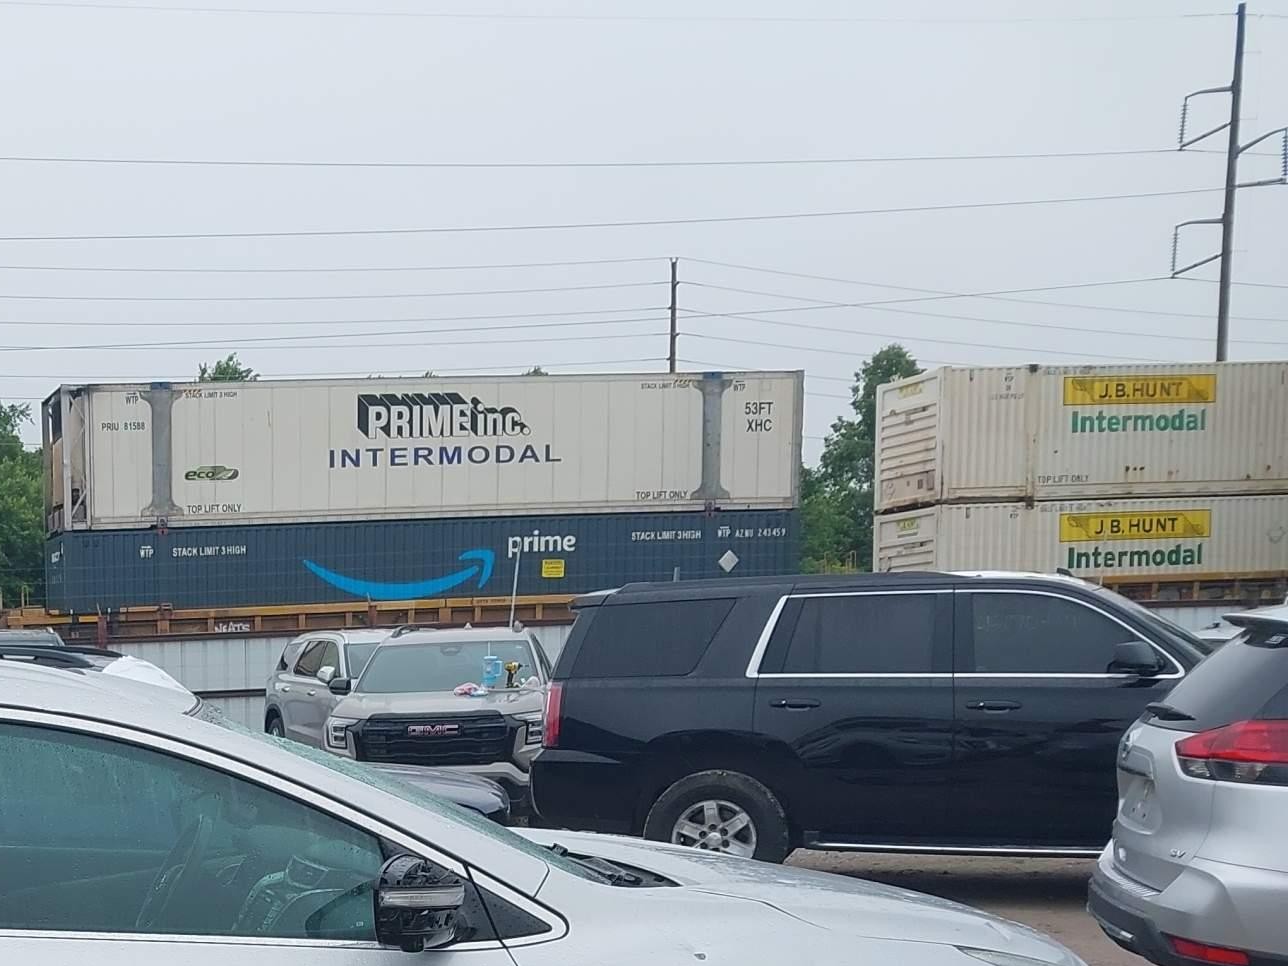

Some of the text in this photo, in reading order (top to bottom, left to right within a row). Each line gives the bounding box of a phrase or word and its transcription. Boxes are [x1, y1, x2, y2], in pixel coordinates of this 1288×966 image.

[125, 395, 139, 405] WTP
[744, 401, 774, 415] 53FT
[357, 392, 531, 439] PRIME inc.
[1071, 408, 1206, 433] Intermodal
[746, 419, 773, 433] XHC
[328, 444, 562, 468] INTERMODAL
[184, 469, 215, 480] eco
[636, 490, 688, 500] TOP LIFT ONLY
[187, 503, 242, 513] TOP LIFT ONLY
[631, 530, 702, 541] STACK LIMIT 3 HIGH
[508, 529, 576, 558] prime
[140, 548, 154, 558] WTP
[172, 545, 247, 557] STACK LIMIT 3 HIGH
[1067, 543, 1203, 569] Intermodal
[407, 724, 459, 737] GMC
